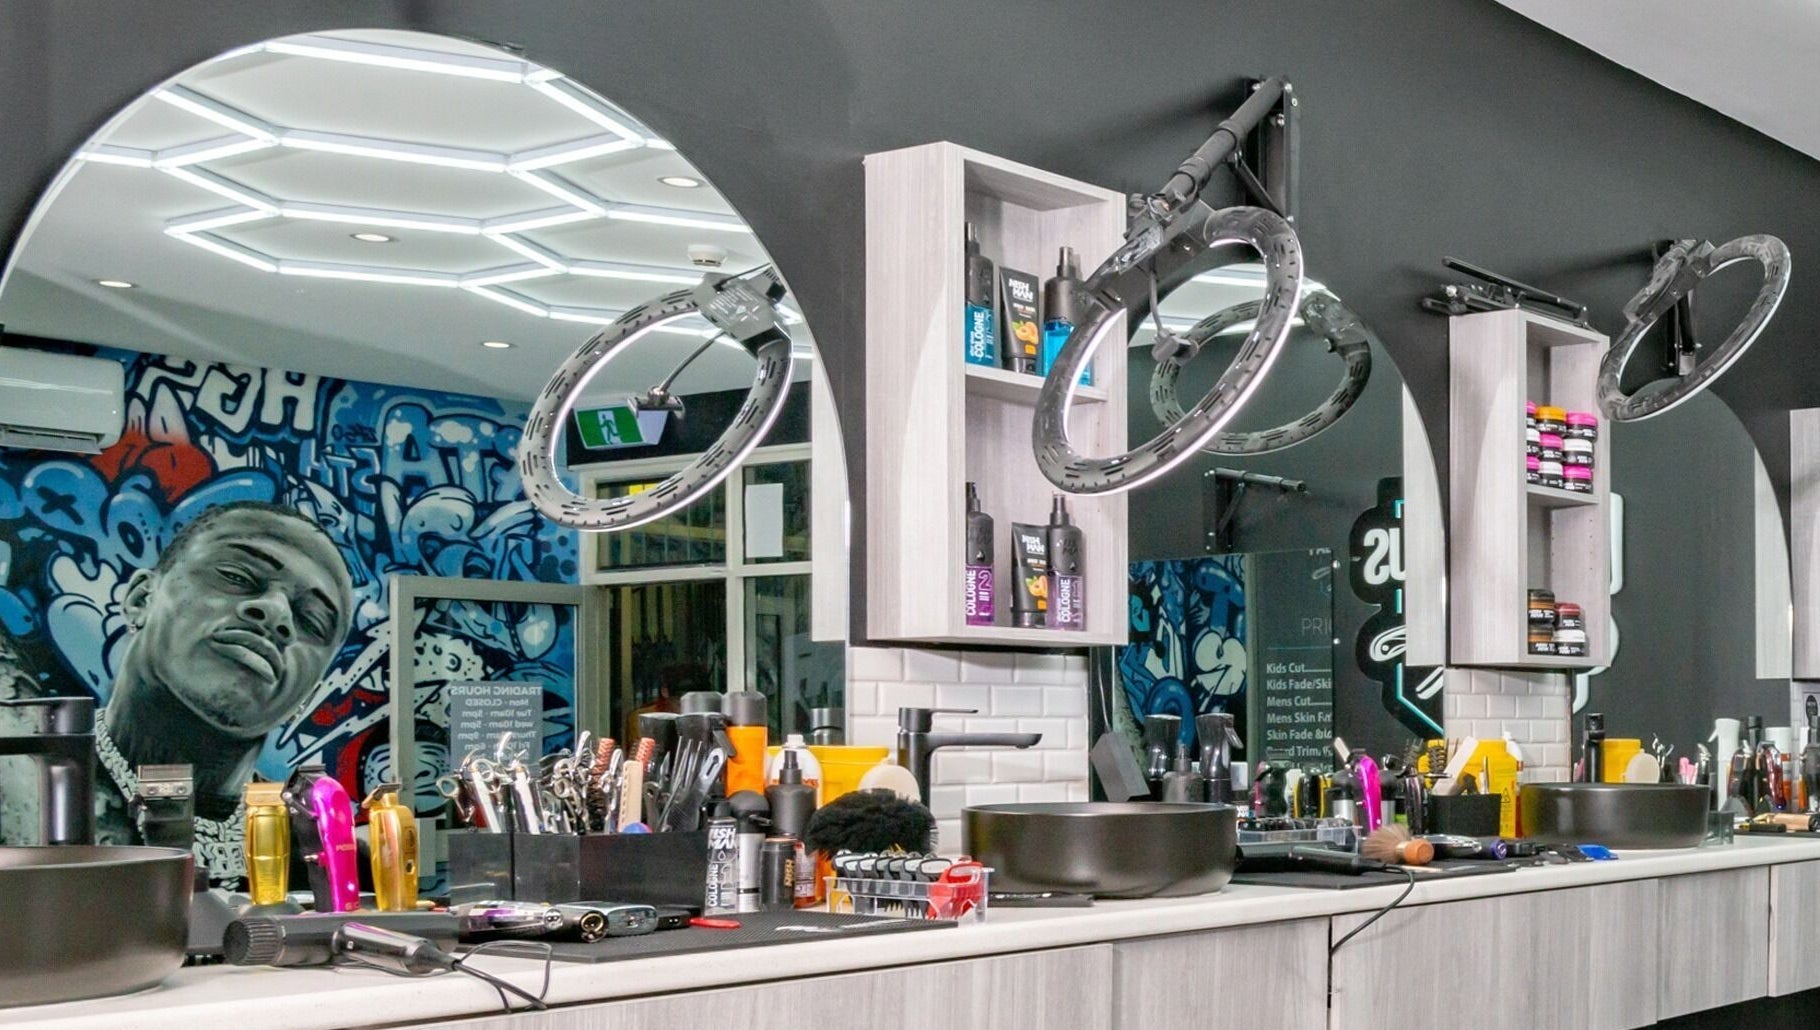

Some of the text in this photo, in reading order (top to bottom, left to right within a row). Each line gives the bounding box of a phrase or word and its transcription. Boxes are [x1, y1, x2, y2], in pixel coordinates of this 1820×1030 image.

[974, 311, 985, 358] COLOGNE
[967, 570, 977, 616] COLOGNE
[1061, 578, 1071, 623] COLOGNE
[1266, 662, 1305, 674] Kids Cut
[1266, 679, 1287, 690] Kids
[1267, 695, 1311, 707] Mens Cut
[1267, 713, 1292, 723] Mens
[1294, 712, 1316, 723] Skin
[1267, 729, 1288, 740] Skin
[1289, 728, 1313, 740] Fade
[708, 863, 719, 907] COLOGNE
